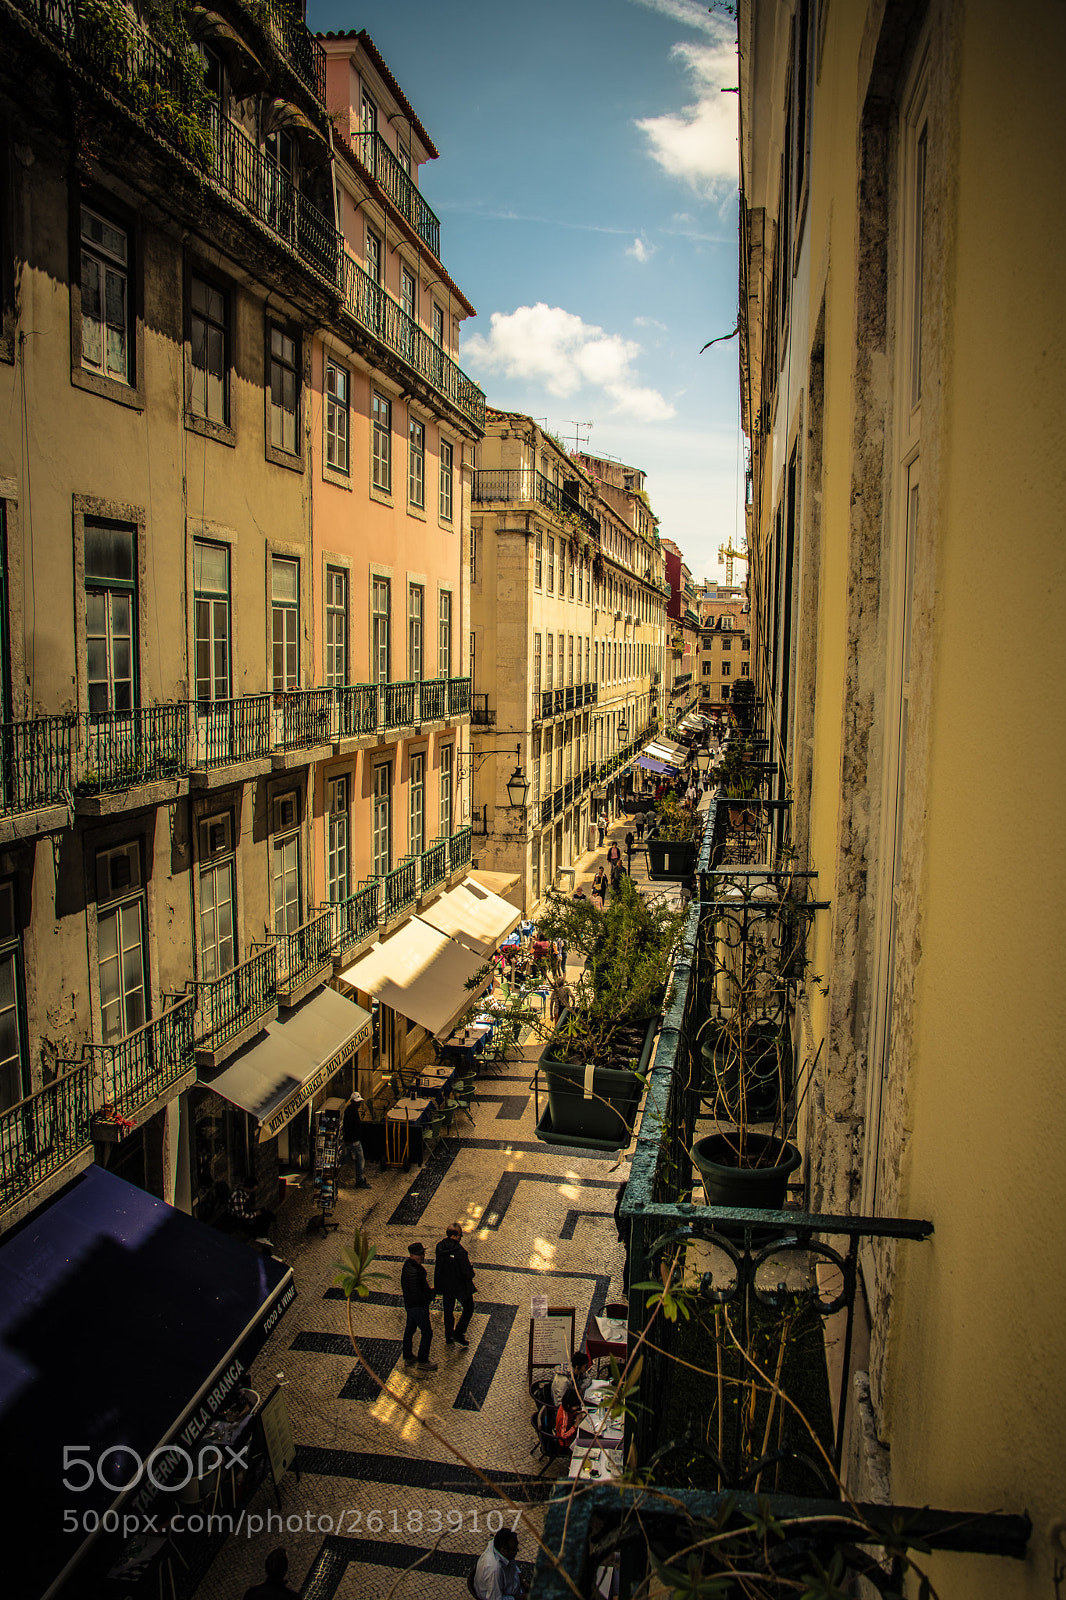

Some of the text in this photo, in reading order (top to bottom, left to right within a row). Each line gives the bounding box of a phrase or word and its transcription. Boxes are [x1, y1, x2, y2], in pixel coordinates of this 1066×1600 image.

[268, 1111, 284, 1135] MINI
[283, 1078, 324, 1119] SUPERMARKET
[325, 1055, 342, 1077] MINI
[341, 1026, 369, 1061] MERCADO
[263, 1284, 296, 1334] FOOD & WINE
[131, 1359, 245, 1514] TABERNA VELA BRANCA
